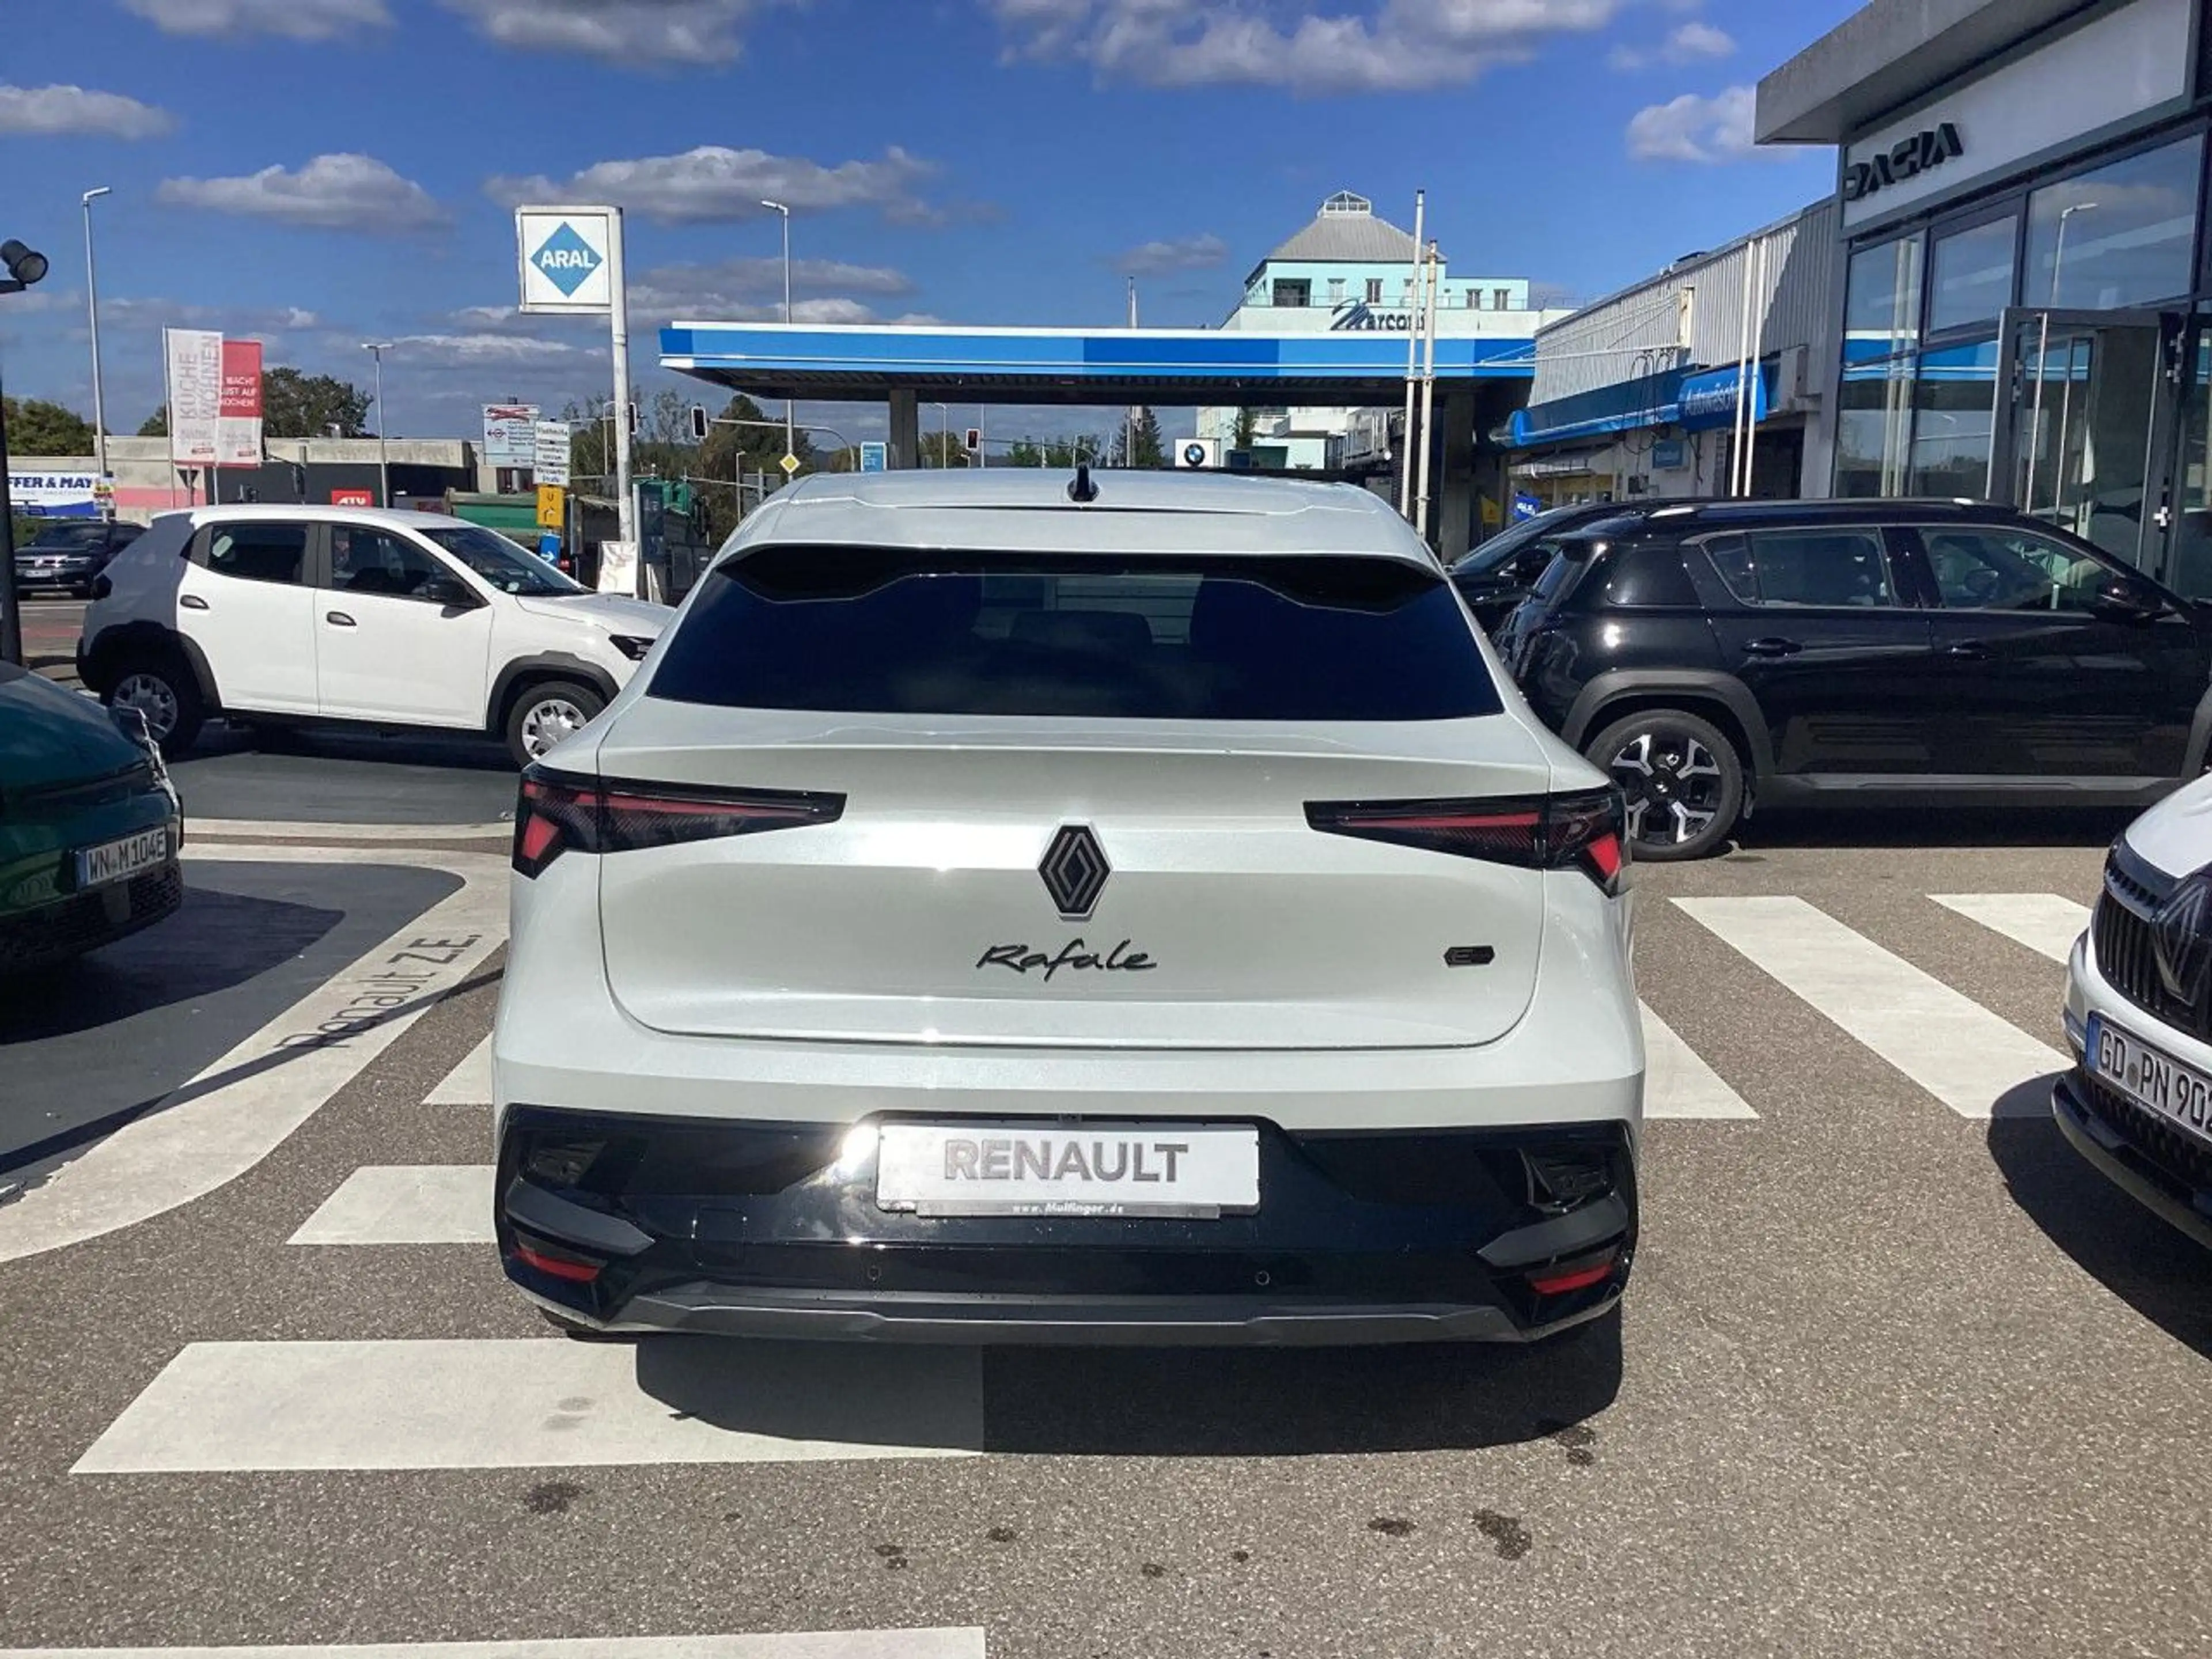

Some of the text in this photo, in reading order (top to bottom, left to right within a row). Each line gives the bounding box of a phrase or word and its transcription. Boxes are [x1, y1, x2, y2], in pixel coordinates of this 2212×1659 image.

[541, 249, 594, 269] ARAL
[46, 476, 56, 488] &
[60, 477, 92, 488] MAY
[975, 938, 1157, 983] Rafale
[2099, 1029, 2127, 1080] GD
[2139, 1051, 2171, 1108] PN
[944, 1138, 1189, 1183] RENAULT
